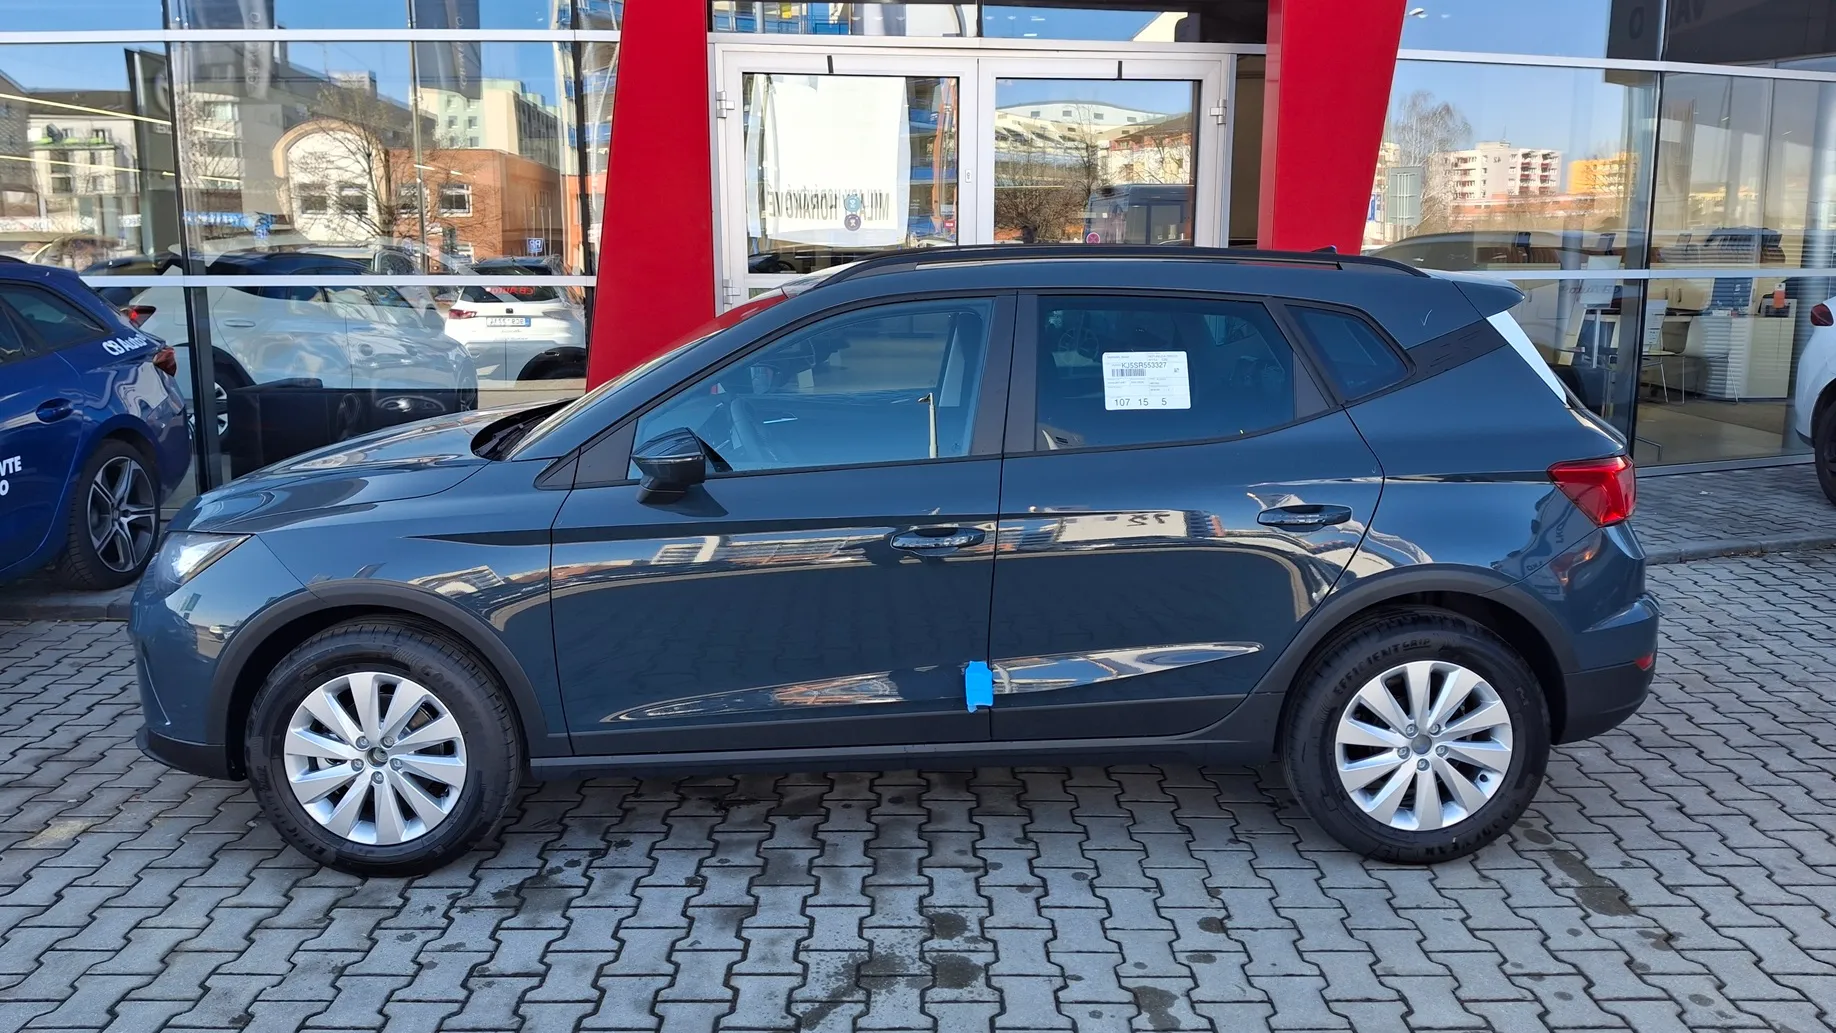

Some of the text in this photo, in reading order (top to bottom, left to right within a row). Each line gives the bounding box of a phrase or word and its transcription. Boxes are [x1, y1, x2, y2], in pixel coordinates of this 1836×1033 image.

[102, 339, 126, 356] CB
[1115, 398, 1168, 406] 107 15 5
[0, 479, 10, 496] O
